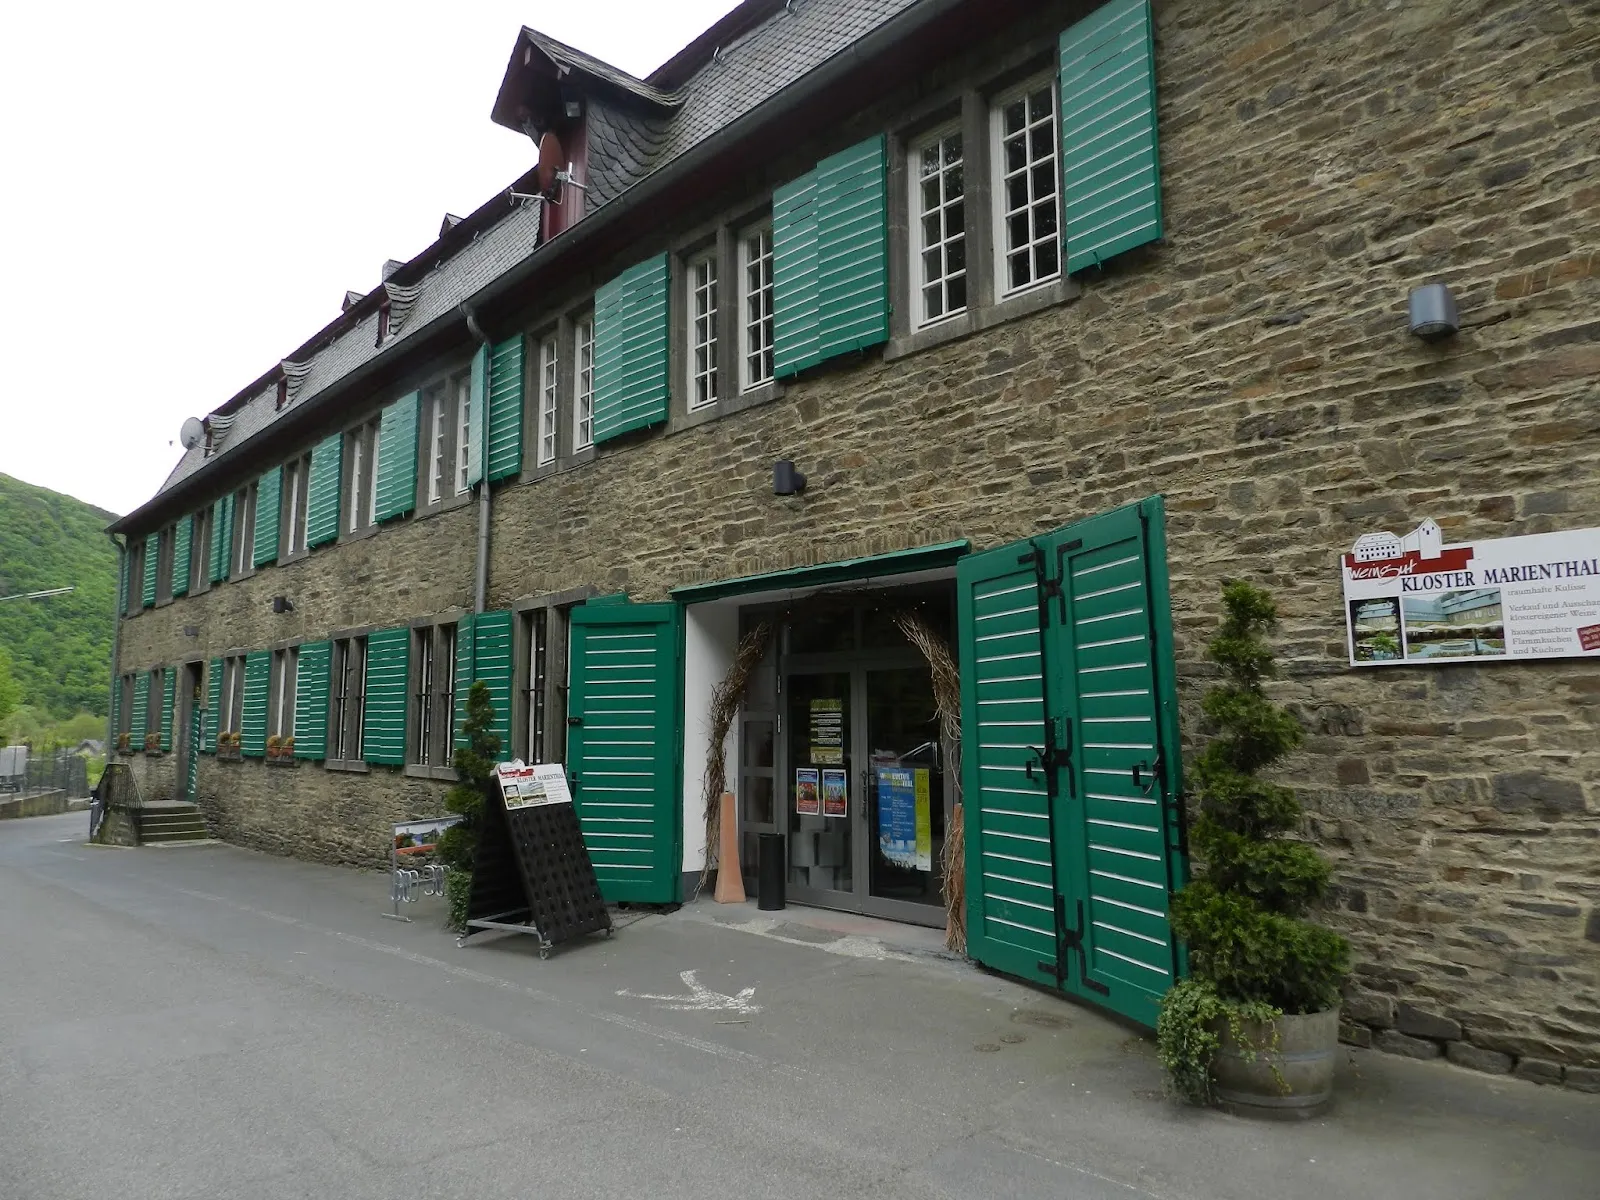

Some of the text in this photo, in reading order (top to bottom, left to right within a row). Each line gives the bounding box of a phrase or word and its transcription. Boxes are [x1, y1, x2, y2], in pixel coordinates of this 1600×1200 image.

[1401, 559, 1600, 592] KLOSTER MARIENTHAL
[1508, 584, 1586, 596] traumhafte Kulisse
[1509, 602, 1541, 612] Verkauf
[1543, 602, 1559, 610] und
[1510, 609, 1597, 621] klostereigener Weine
[1511, 626, 1573, 636] hausgemachter
[1512, 635, 1573, 645] Flammkuchen
[1513, 646, 1565, 655] und Kuchen
